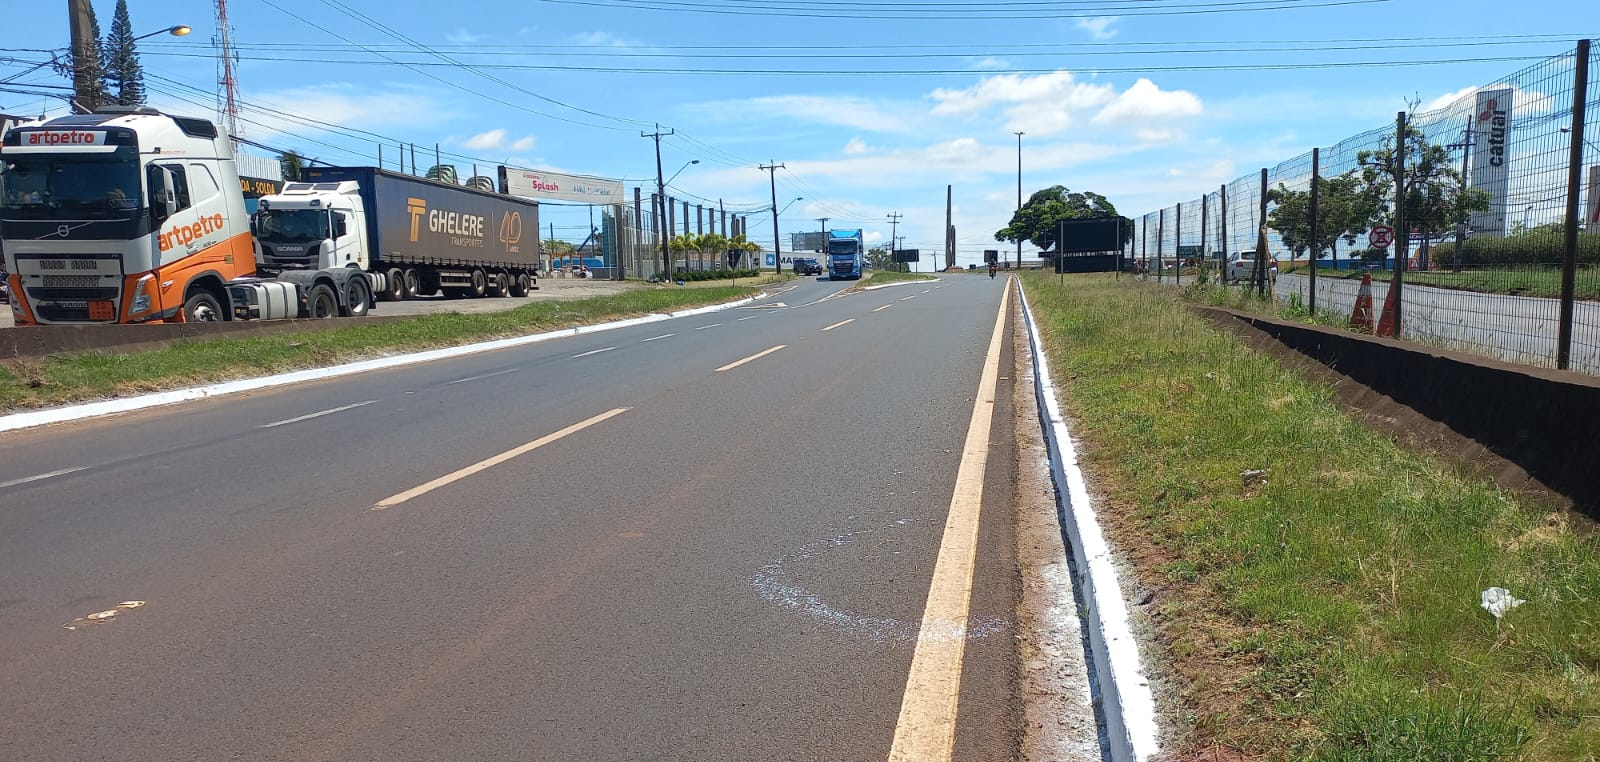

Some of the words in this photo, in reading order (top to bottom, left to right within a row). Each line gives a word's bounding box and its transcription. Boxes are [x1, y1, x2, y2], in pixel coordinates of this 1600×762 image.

[28, 130, 95, 145] artpetro
[255, 181, 276, 195] SOLDA
[532, 179, 559, 192] Splash
[429, 209, 484, 237] GHELERE
[157, 213, 224, 252] artpetro
[451, 236, 483, 248] TRANSPORTES
